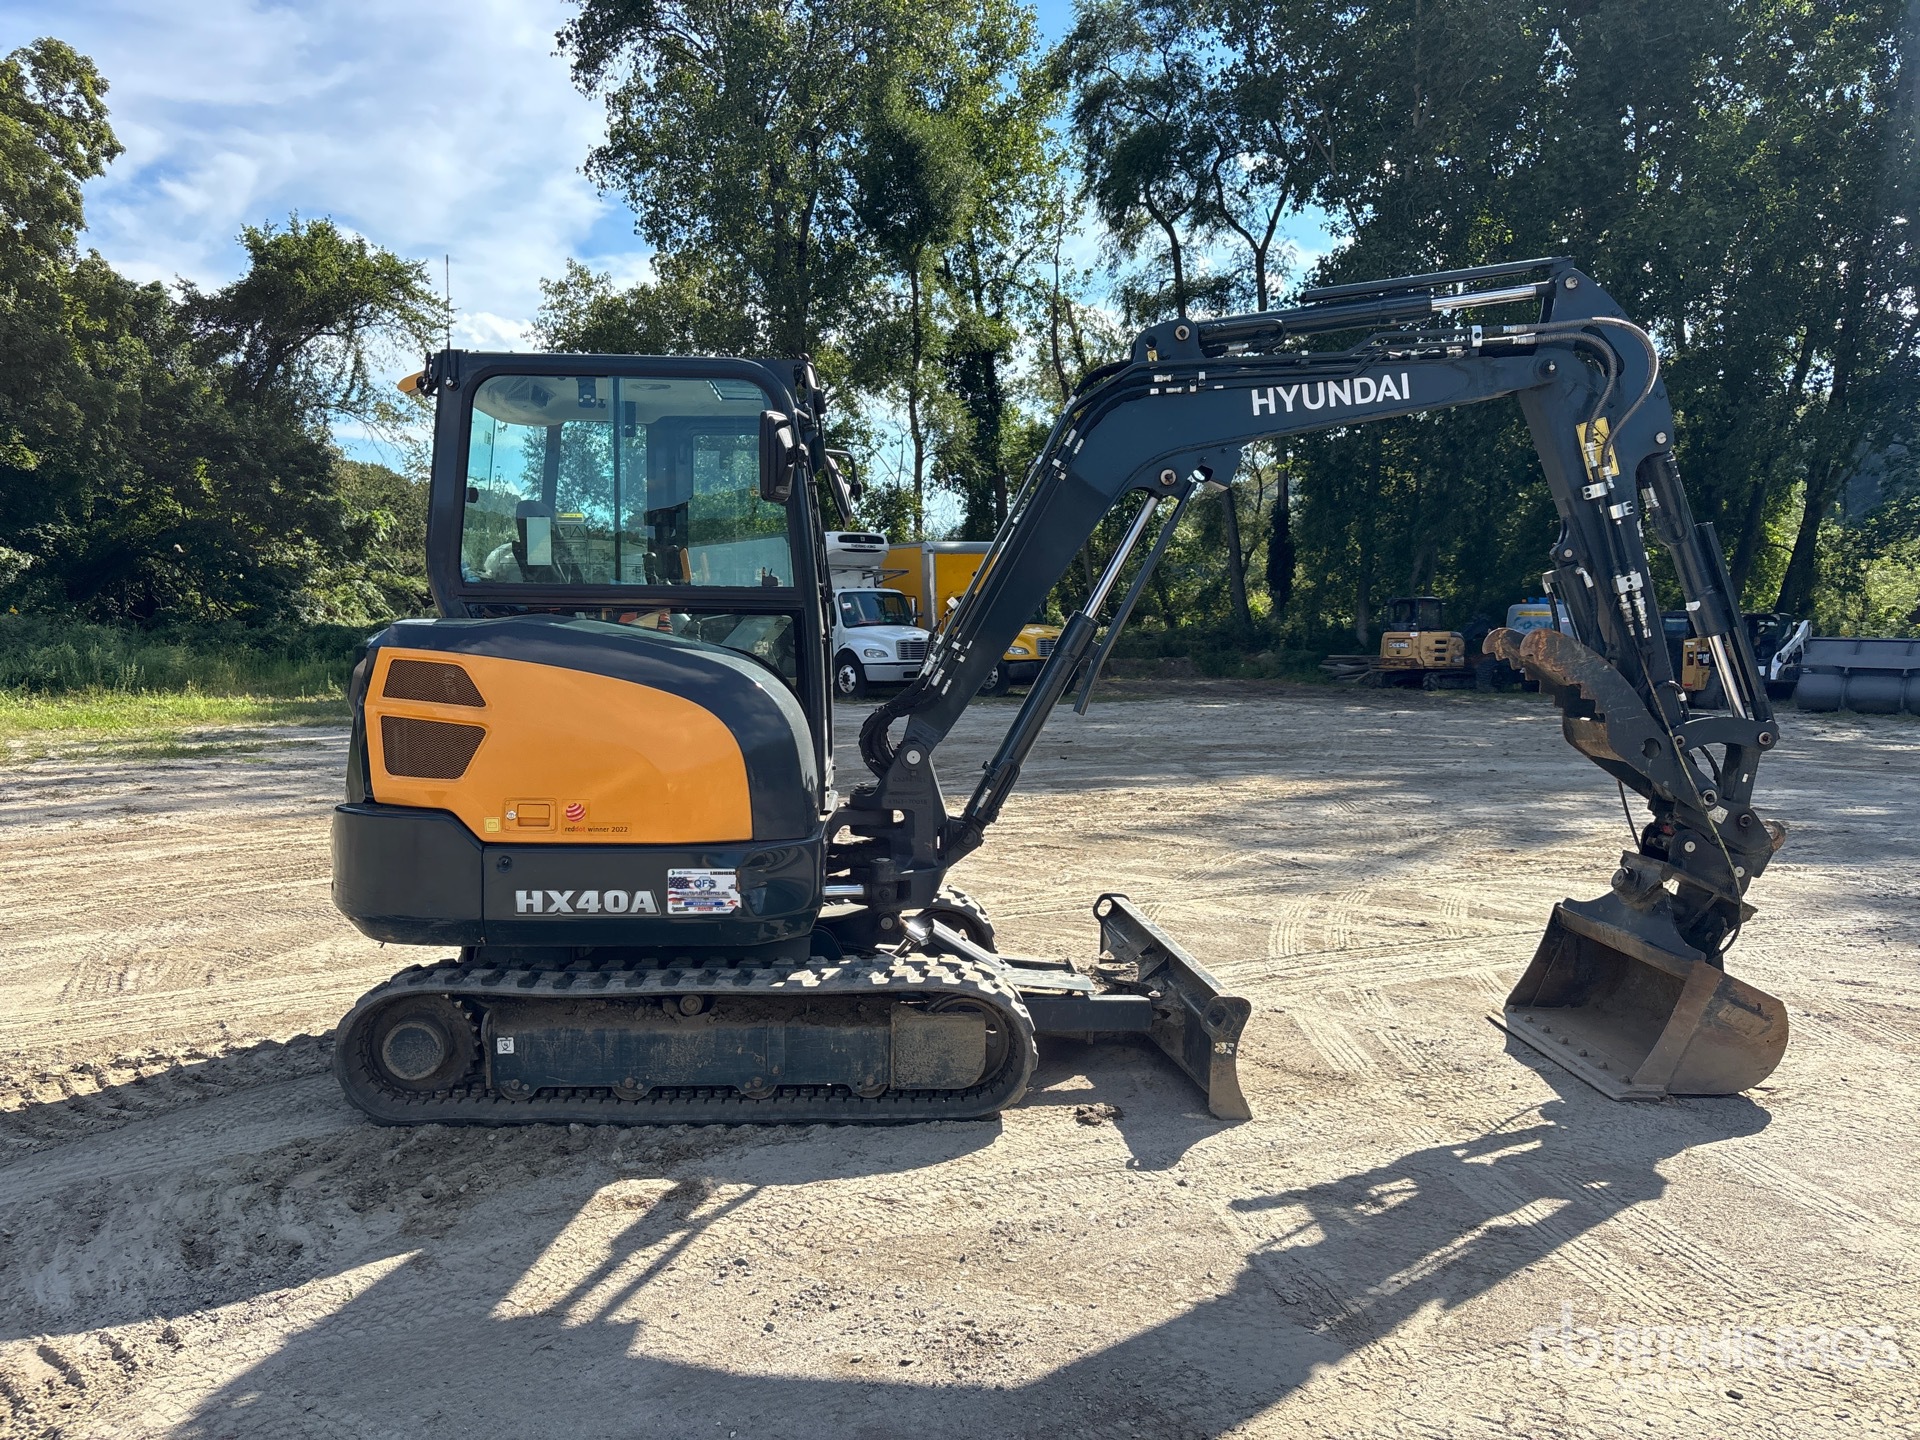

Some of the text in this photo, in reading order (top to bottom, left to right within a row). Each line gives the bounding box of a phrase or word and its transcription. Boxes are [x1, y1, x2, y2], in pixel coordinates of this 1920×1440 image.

[1251, 372, 1410, 416] HYUNDAI
[694, 879, 717, 889] QFS
[515, 889, 658, 914] HX40A
